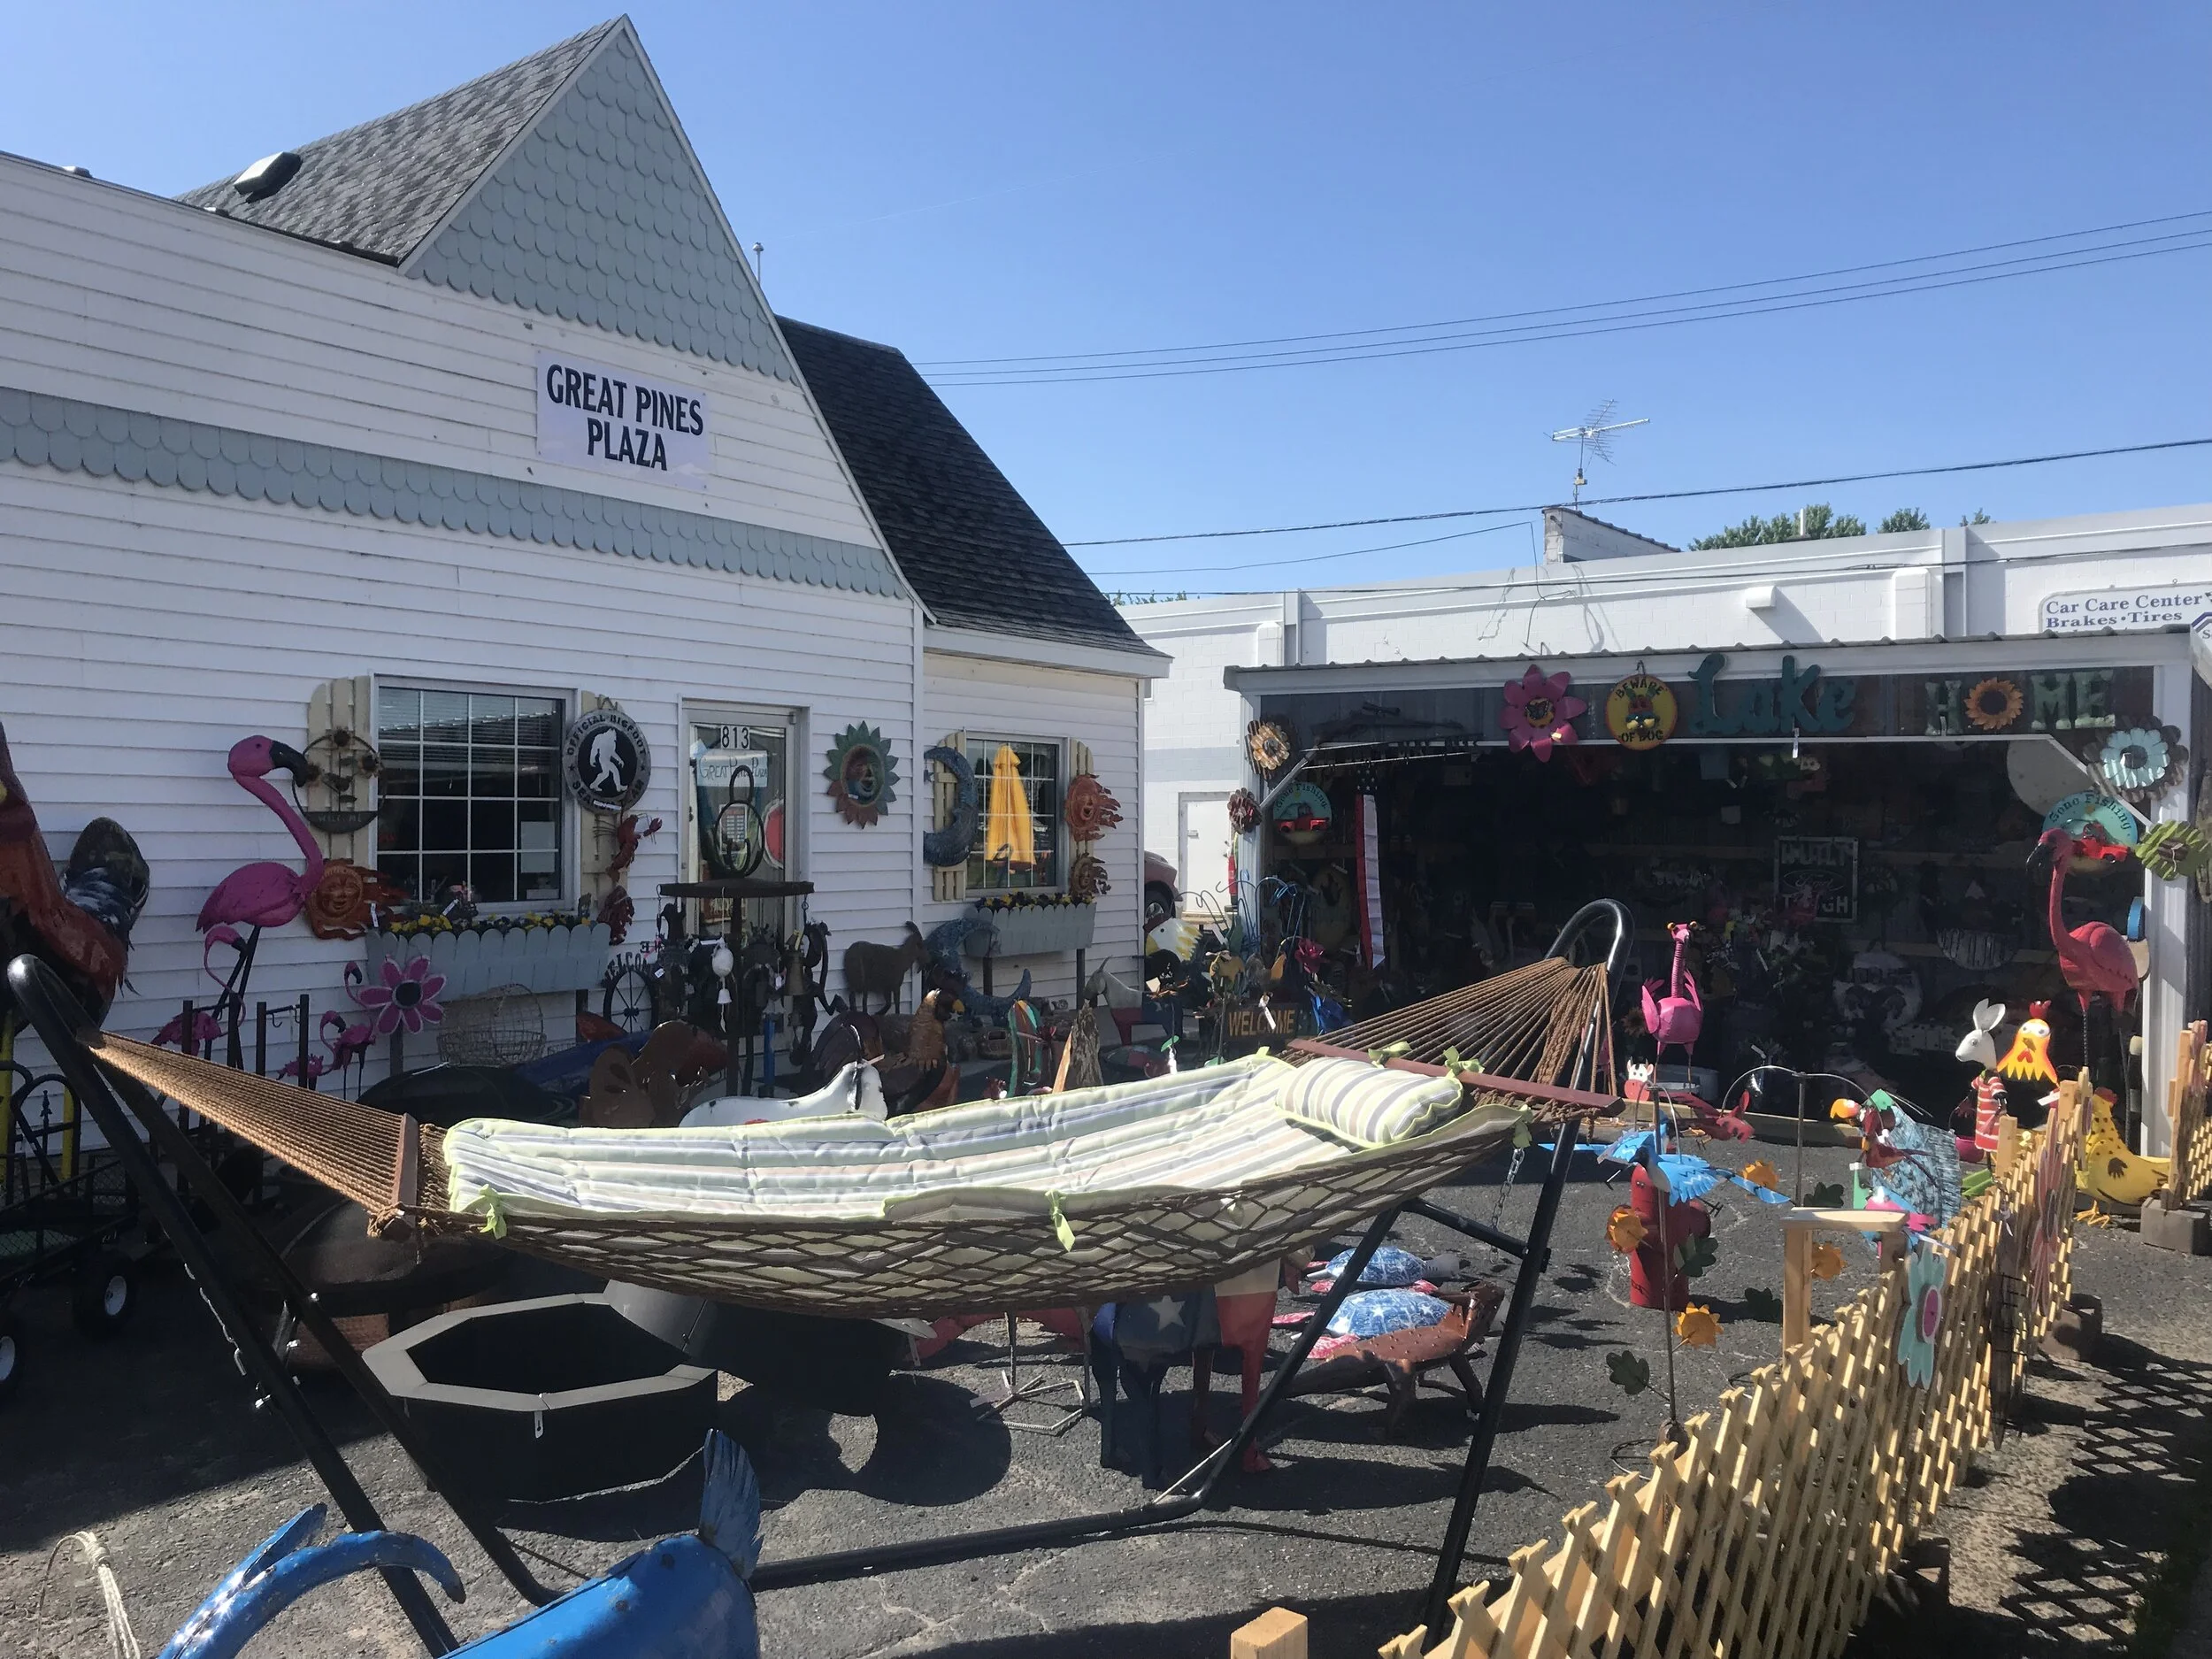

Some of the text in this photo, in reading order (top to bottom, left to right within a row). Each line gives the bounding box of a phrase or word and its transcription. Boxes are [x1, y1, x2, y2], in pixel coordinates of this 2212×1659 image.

[546, 364, 703, 435] GREAT PINES
[587, 417, 667, 471] PLAZA
[2046, 594, 2203, 614] Car Care Center
[2046, 611, 2183, 628] Brakes Tires
[1615, 676, 1664, 699] BEWARE
[1687, 652, 1856, 734] Lake
[567, 714, 647, 756] OFFICIAL BIGFOOT
[721, 726, 749, 749] 813
[1621, 729, 1664, 743] OF DOG
[699, 755, 728, 780] GREAT
[2085, 793, 2132, 831] Fishing
[1228, 1009, 1295, 1037] WELCOME
